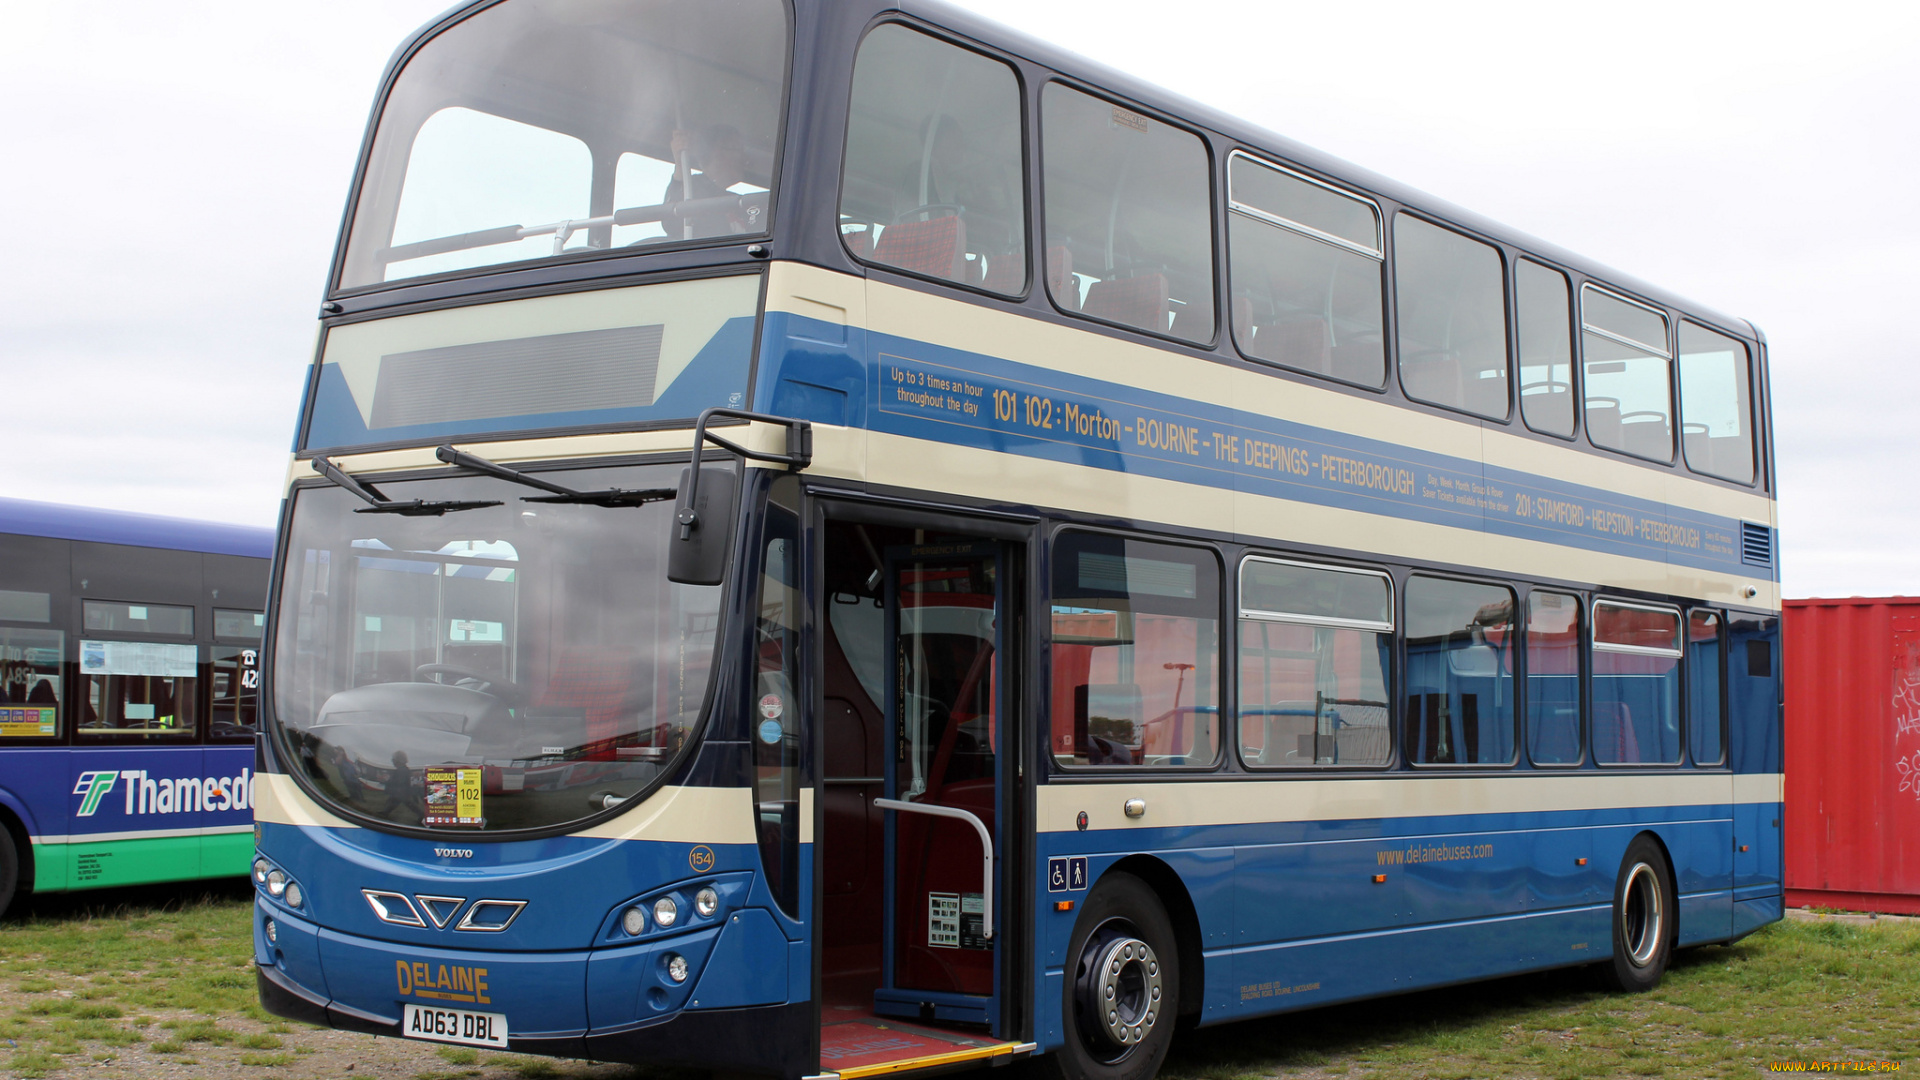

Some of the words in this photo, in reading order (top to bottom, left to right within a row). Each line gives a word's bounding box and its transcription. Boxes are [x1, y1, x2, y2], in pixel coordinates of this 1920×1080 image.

[891, 366, 904, 384] Up
[906, 370, 916, 384] to
[918, 372, 925, 386] 3
[926, 374, 950, 391] times
[952, 381, 963, 393] an
[964, 381, 983, 397] hour
[897, 386, 944, 408] throughout
[947, 396, 960, 411] the
[963, 399, 978, 417] day
[993, 388, 1016, 423] 101
[1065, 402, 1120, 441] Morton
[1136, 417, 1199, 456] BOURNE
[1212, 432, 1239, 463] THE
[1244, 438, 1309, 476] DEEPINGS
[1321, 454, 1415, 496] PETERBOROUGH
[1537, 497, 1584, 527] STAMFORD
[1592, 509, 1634, 536] HELPSTON
[1640, 518, 1700, 549] PETERBOROUGH
[911, 545, 954, 555] EMERGENCY
[956, 544, 973, 554] EXIT
[460, 788, 480, 800] 102
[434, 848, 474, 858] VOLVO
[692, 852, 711, 865] 154
[1376, 842, 1493, 865] www.delainebuses.com
[396, 960, 491, 1004] DELAINE
[412, 1009, 458, 1036] AD63
[463, 1014, 499, 1041] DBL
